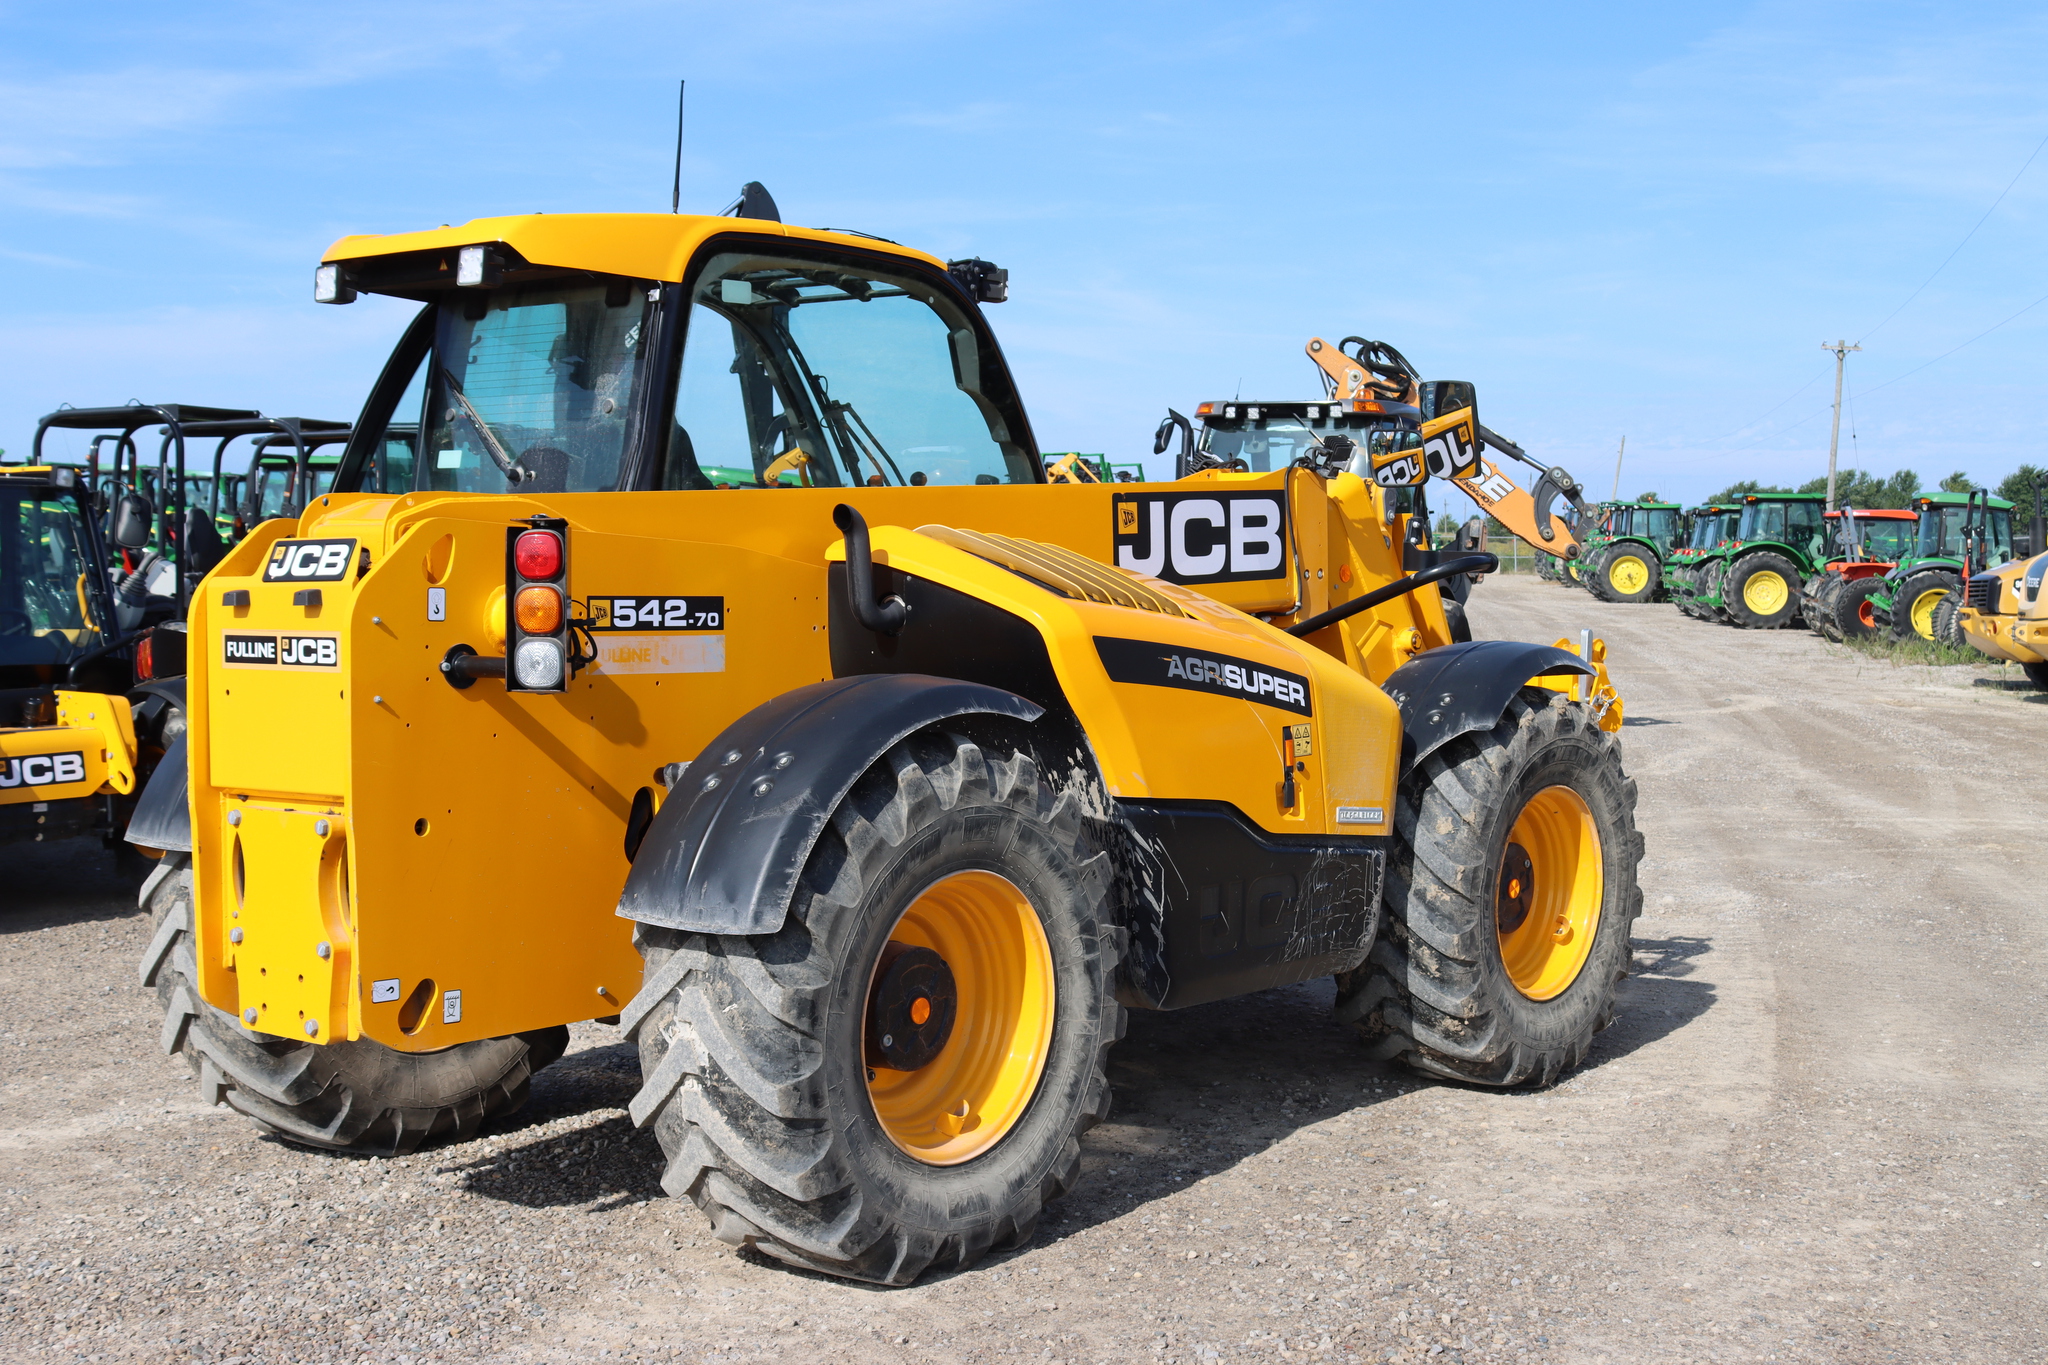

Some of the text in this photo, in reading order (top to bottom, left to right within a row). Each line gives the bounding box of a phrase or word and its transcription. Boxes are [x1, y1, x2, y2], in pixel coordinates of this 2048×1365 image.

[1459, 478, 1495, 507] ENDAHOE
[1118, 499, 1282, 577] JCB
[268, 544, 349, 577] JCB
[226, 639, 337, 664] FULLINE JCB
[1167, 655, 1306, 707] AGRISUPER
[0, 753, 85, 787] JCB
